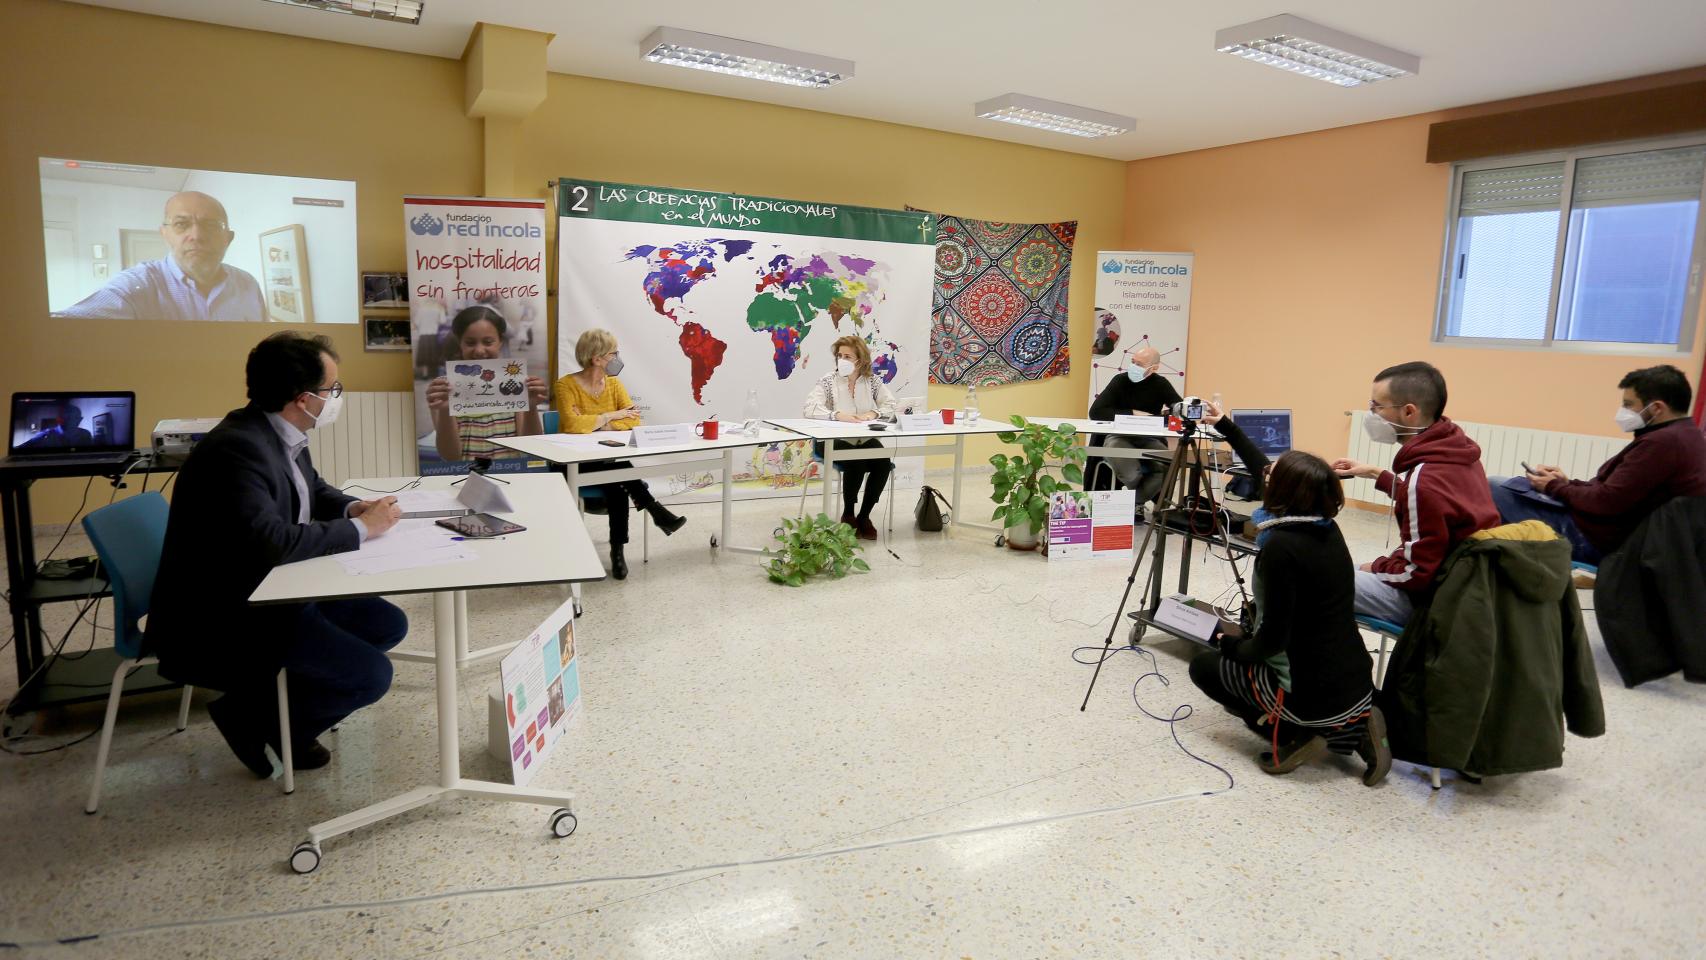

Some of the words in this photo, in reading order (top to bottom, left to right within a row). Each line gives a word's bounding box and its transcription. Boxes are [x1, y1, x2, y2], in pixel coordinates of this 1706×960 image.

[571, 185, 589, 212] 2
[600, 185, 627, 203] LAS
[661, 210, 683, 221] en
[687, 208, 705, 225] el
[706, 212, 761, 228] MUNDO
[447, 220, 480, 237] red
[485, 222, 541, 238] incola
[416, 248, 540, 280] hospitalidad
[1124, 263, 1146, 274] red
[1149, 265, 1187, 275] incola
[416, 280, 444, 299] sin
[452, 282, 539, 300] fronteras
[1159, 280, 1169, 288] de
[1171, 280, 1179, 288] la
[1108, 302, 1123, 310] con
[1124, 302, 1132, 310] el
[1133, 302, 1157, 311] teatro
[1158, 303, 1181, 312] social
